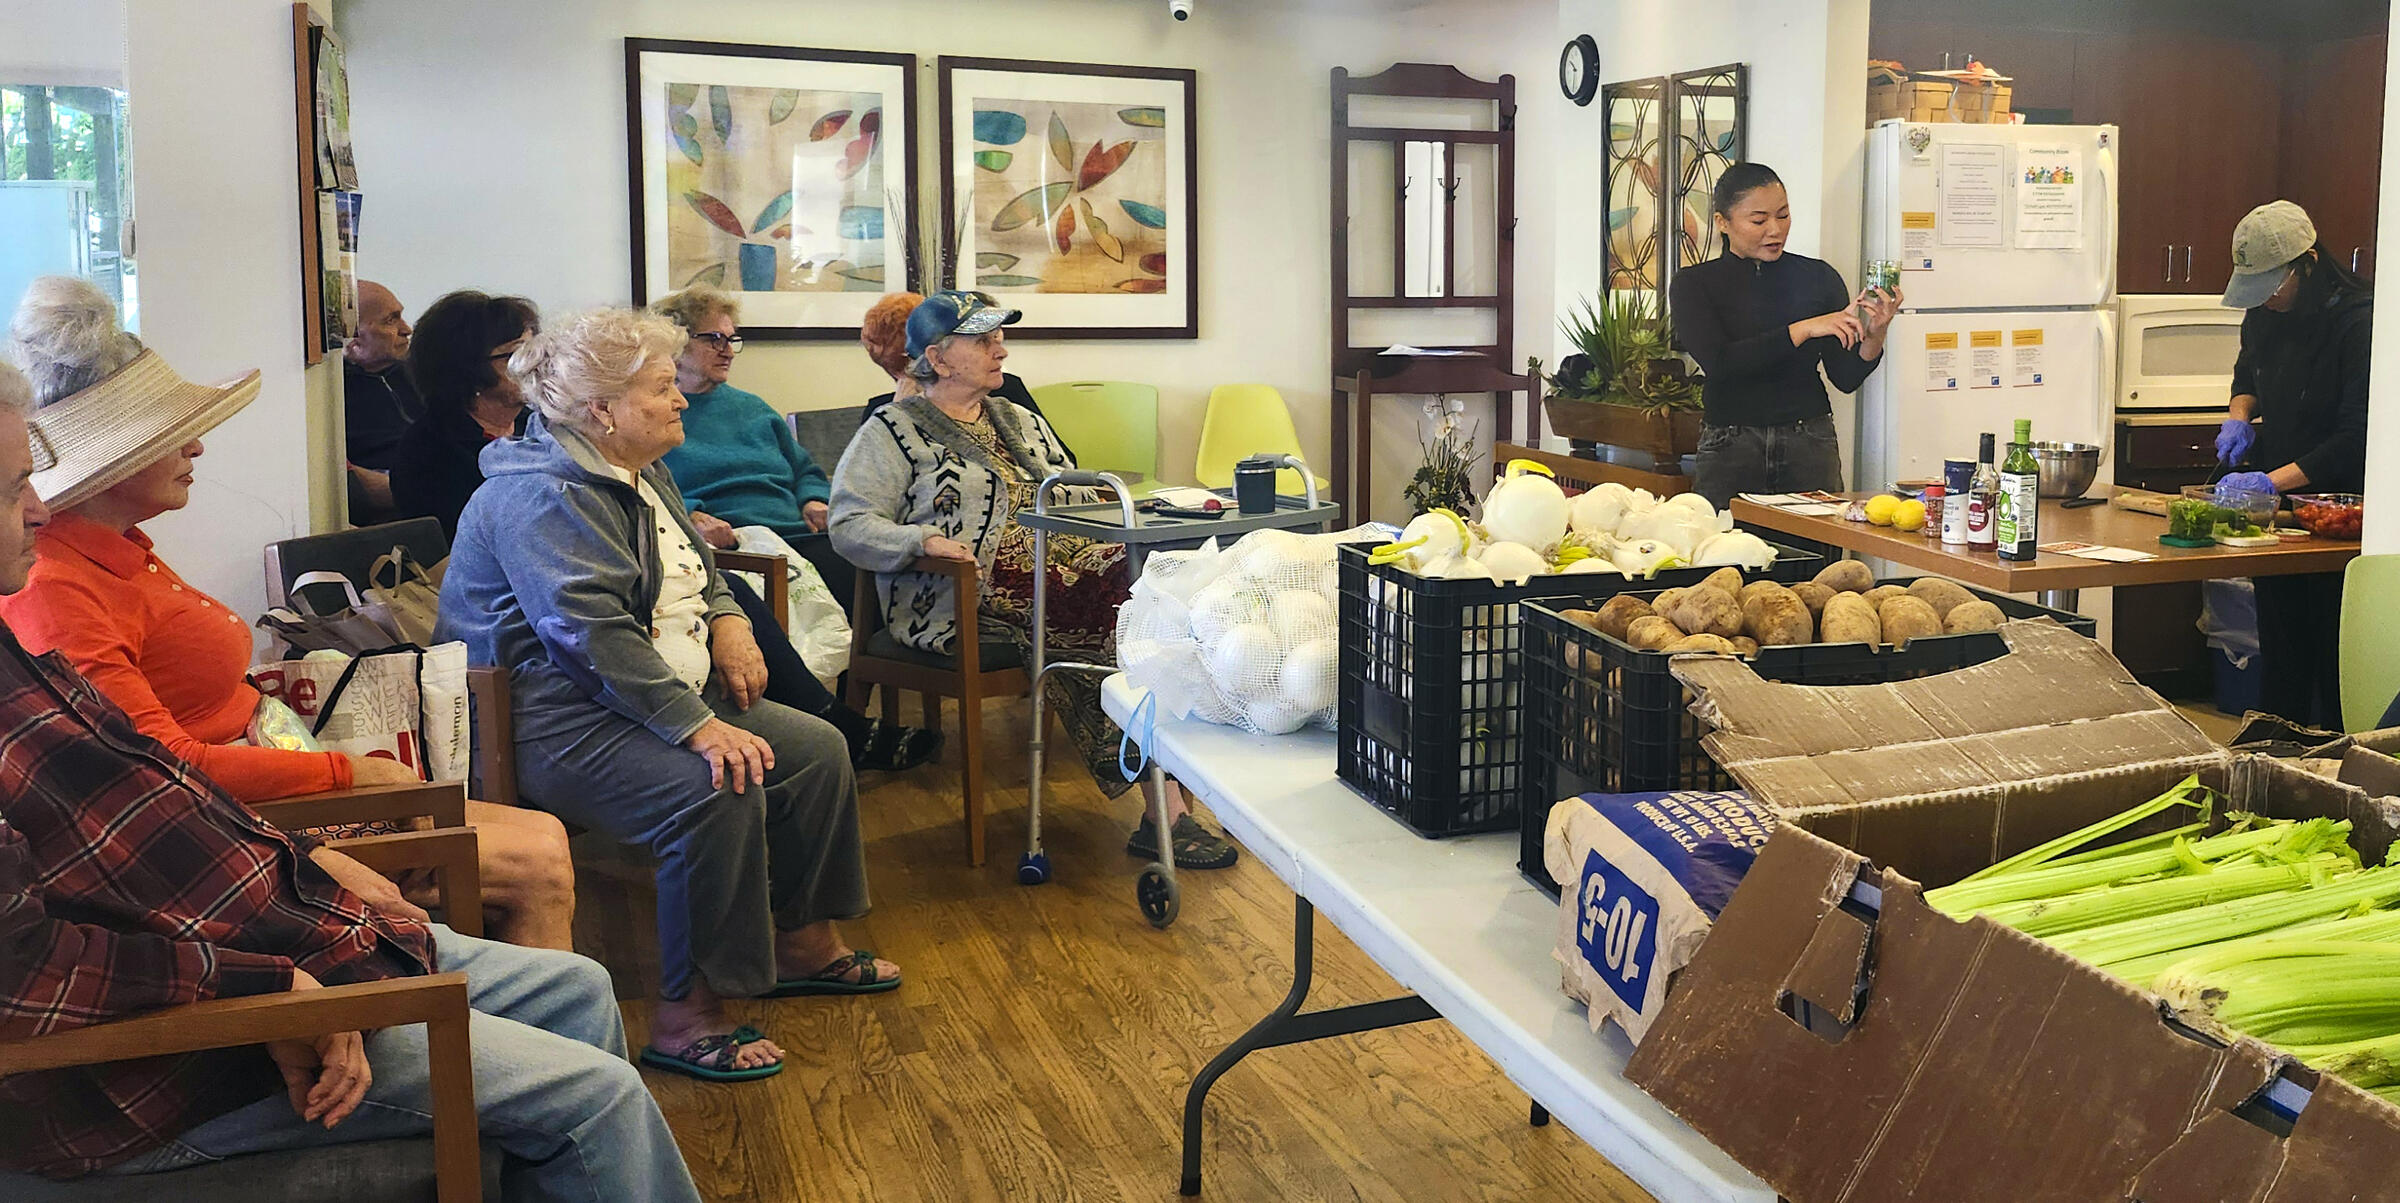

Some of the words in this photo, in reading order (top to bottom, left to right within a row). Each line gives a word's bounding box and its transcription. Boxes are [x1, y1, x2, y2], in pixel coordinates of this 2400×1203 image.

[1632, 801, 1671, 828] PRODUCE
[1671, 828, 1699, 854] U.S.A.
[1710, 798, 1769, 854] PRODUC
[1581, 872, 1648, 984] 10-5
